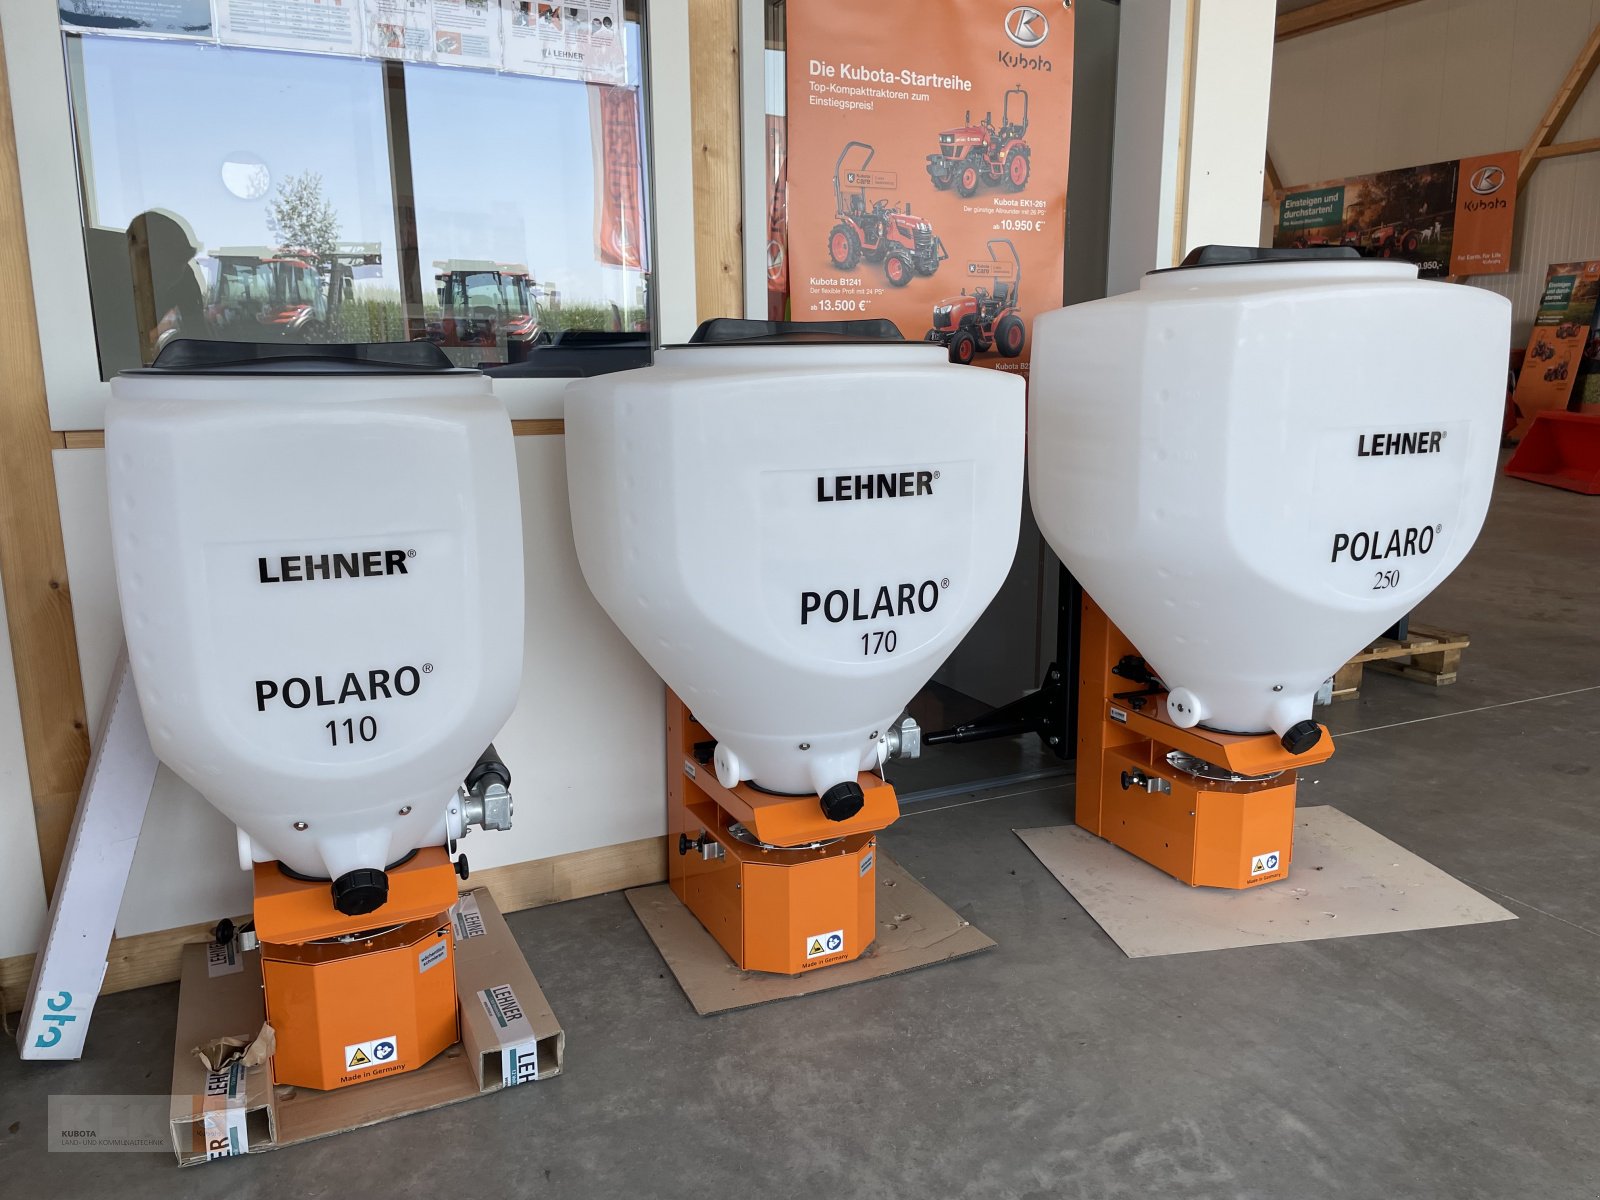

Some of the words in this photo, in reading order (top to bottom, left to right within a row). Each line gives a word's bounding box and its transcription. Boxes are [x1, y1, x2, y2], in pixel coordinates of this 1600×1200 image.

[998, 50, 1052, 72] Kubota
[809, 60, 835, 77] Die
[840, 63, 972, 92] Kubota-Startreihe
[809, 81, 909, 100] Top-Kompakttraktoren
[911, 92, 930, 102] zum
[809, 95, 874, 111] Einstiegspreis!
[993, 198, 1019, 207] Kubota
[1285, 196, 1322, 209] Einsteigen
[1323, 192, 1339, 203] und
[1464, 198, 1507, 212] Kubota
[1284, 204, 1333, 219] durchstarten!
[1001, 220, 1033, 231] 10.950
[810, 277, 838, 286] Kubota
[840, 278, 862, 286] B1241
[819, 300, 856, 311] 13.500
[995, 362, 1019, 370] Kubota
[1373, 570, 1400, 590] 250
[861, 630, 897, 656] 170
[325, 715, 378, 746] 110
[802, 961, 817, 969] Made
[825, 954, 849, 963] Germany
[493, 986, 522, 1022] LEHNER
[340, 1074, 361, 1083] Made
[372, 1064, 405, 1076] Germany
